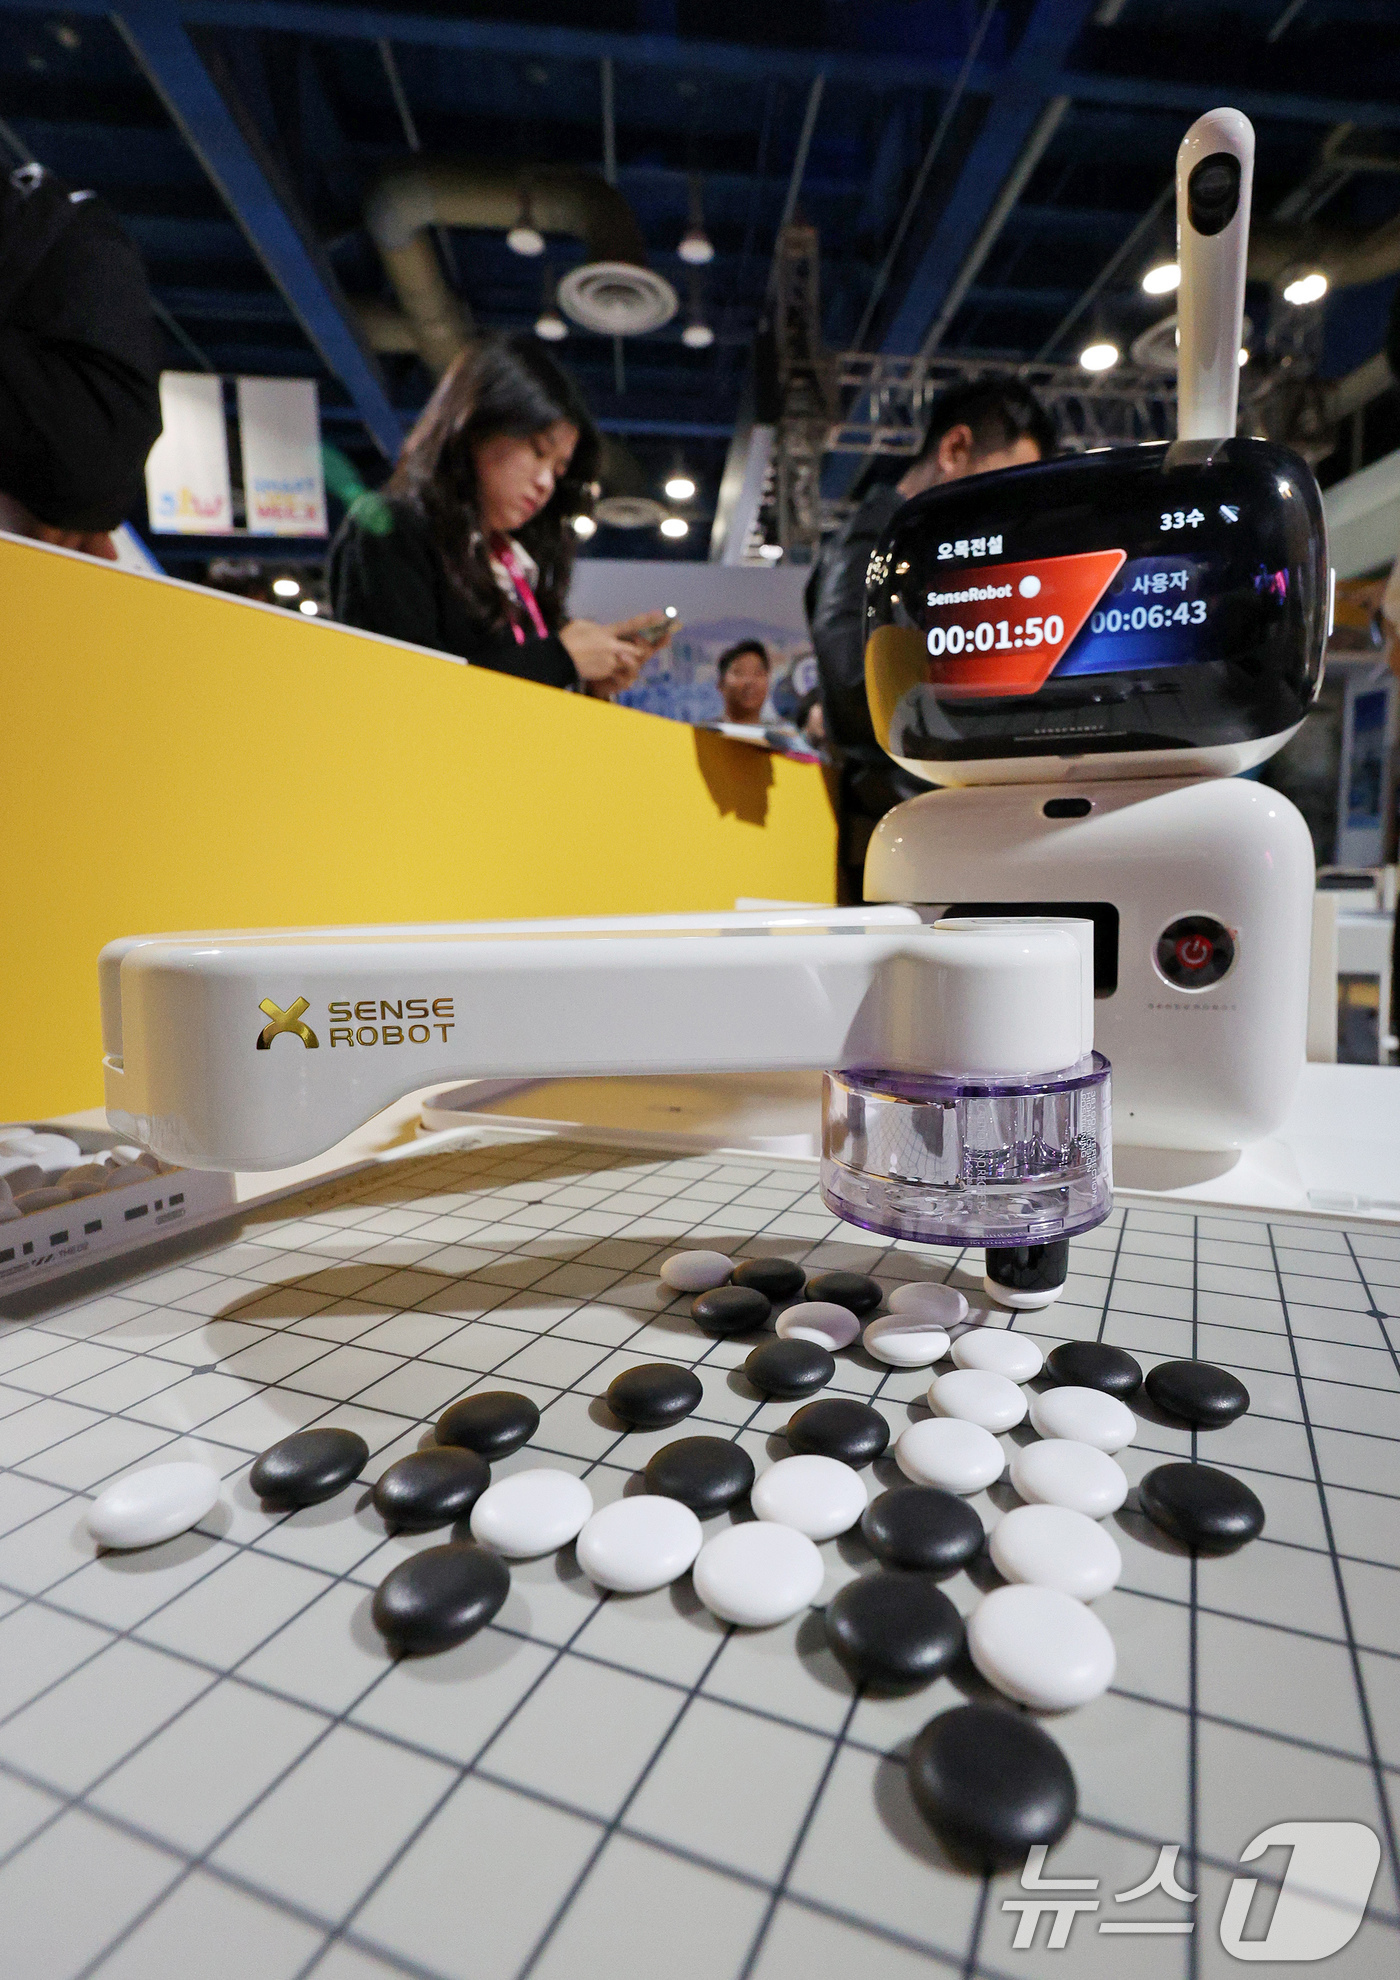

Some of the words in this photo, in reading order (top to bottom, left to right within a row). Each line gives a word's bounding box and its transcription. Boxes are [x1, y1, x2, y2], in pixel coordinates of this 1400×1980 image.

[1160, 508, 1205, 531] 33수
[937, 534, 1003, 560] 오목전설
[927, 583, 1013, 607] SenseRobot
[1131, 570, 1189, 595] 사용자
[1091, 600, 1207, 634] 00:06:43
[927, 614, 1065, 656] 00:01:50
[328, 997, 455, 1023] SENSE
[329, 1023, 455, 1048] ROBOT
